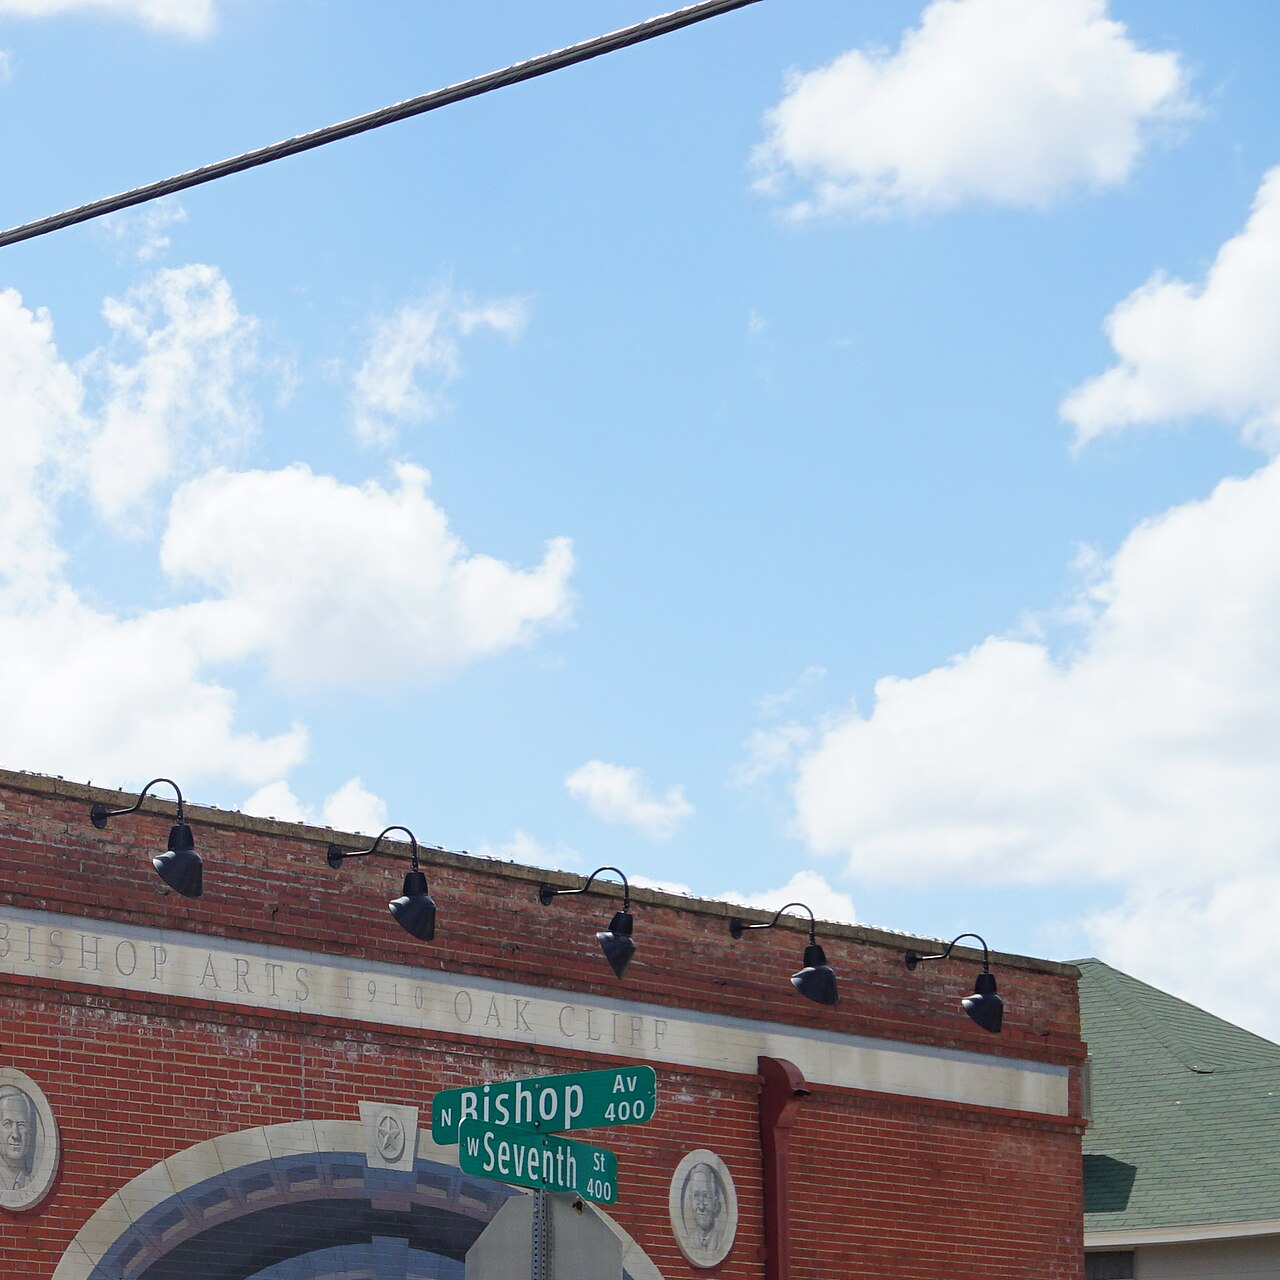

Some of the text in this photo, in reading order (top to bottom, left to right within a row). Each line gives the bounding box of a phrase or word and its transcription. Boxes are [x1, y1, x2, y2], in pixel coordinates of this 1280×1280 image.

[199, 953, 311, 1002] ARTS
[343, 976, 424, 1010] 1910
[453, 990, 533, 1033] OAK
[558, 1005, 668, 1050] CLIFF
[441, 1074, 638, 1129] N Bishop Av
[604, 1100, 645, 1121] 400
[467, 1131, 606, 1189] W Seventh St
[586, 1178, 612, 1201] 400
